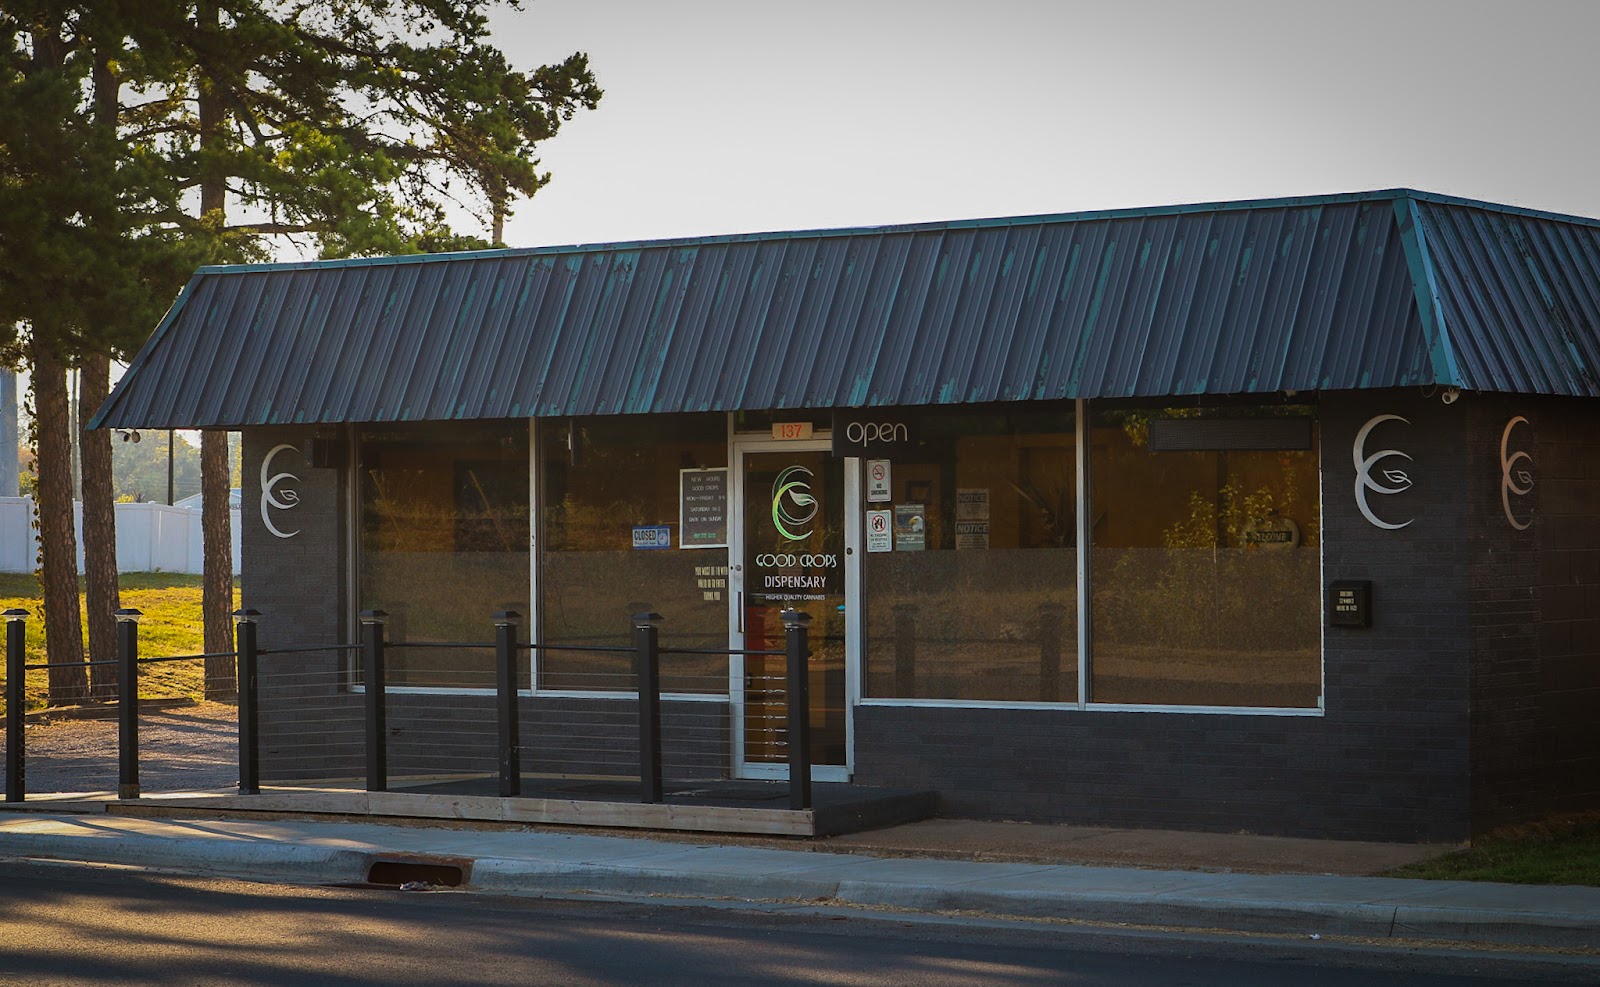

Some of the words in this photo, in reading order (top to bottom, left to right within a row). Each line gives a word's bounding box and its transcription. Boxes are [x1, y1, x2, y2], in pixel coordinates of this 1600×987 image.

[782, 425, 802, 437] 137
[847, 422, 907, 447] open
[960, 494, 986, 502] NOTICE
[958, 524, 988, 533] NOTICE
[634, 530, 656, 540] CLOSED
[756, 553, 796, 567] GOOD
[800, 554, 837, 567] CROPS
[765, 575, 826, 588] DISPENSARY
